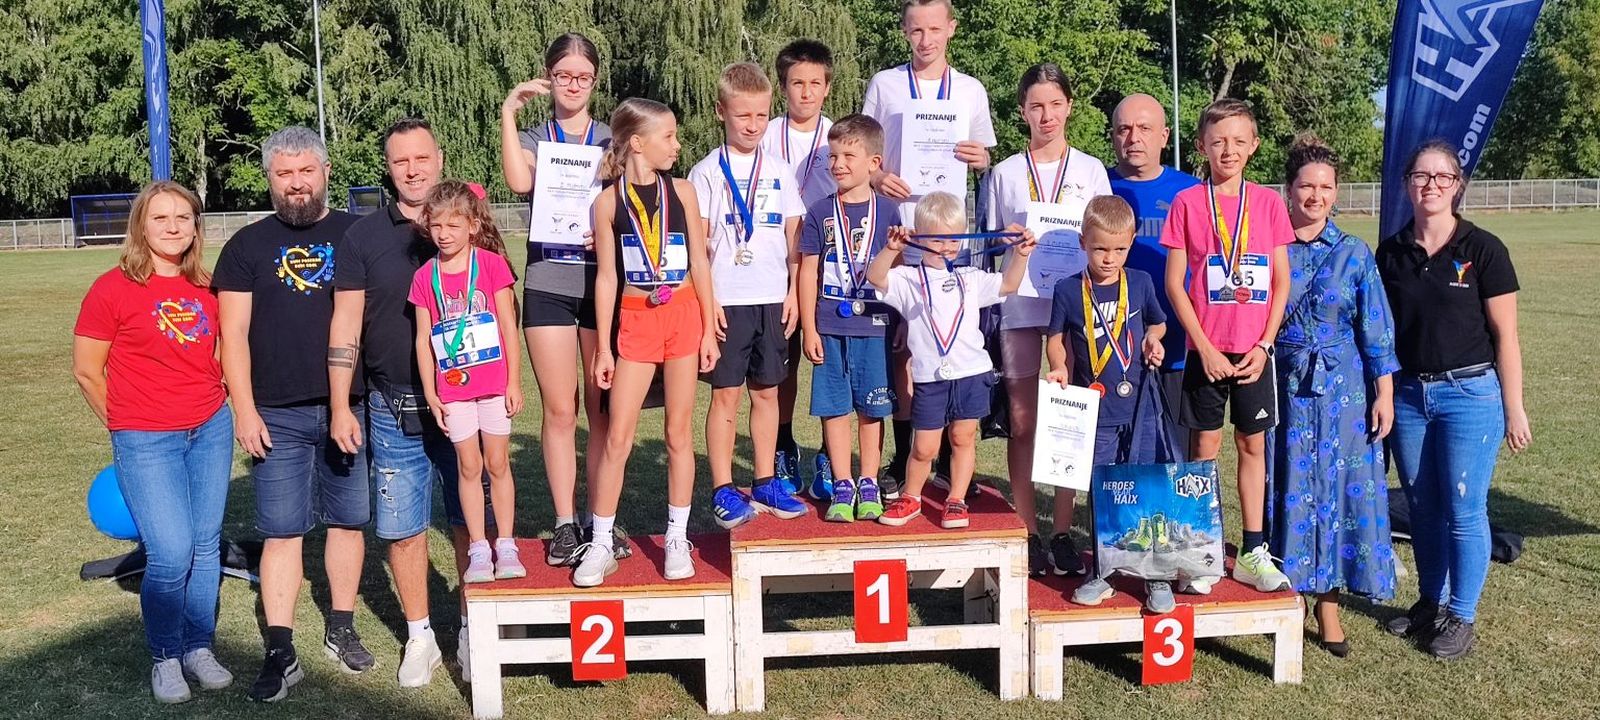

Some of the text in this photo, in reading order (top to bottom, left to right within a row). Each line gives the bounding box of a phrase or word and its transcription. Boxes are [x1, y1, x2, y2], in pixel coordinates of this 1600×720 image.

[915, 113, 957, 122] PRIZNANJE
[550, 157, 592, 168] PRIZNANJE
[1039, 216, 1083, 227] PRIZNANJE
[1231, 270, 1254, 286] 65
[1050, 397, 1088, 411] PRIZNANJE
[1102, 481, 1135, 490] HEROES
[1114, 494, 1138, 504] HAIX
[866, 573, 890, 624] 1
[580, 614, 616, 664] 2
[1152, 617, 1184, 667] 3
